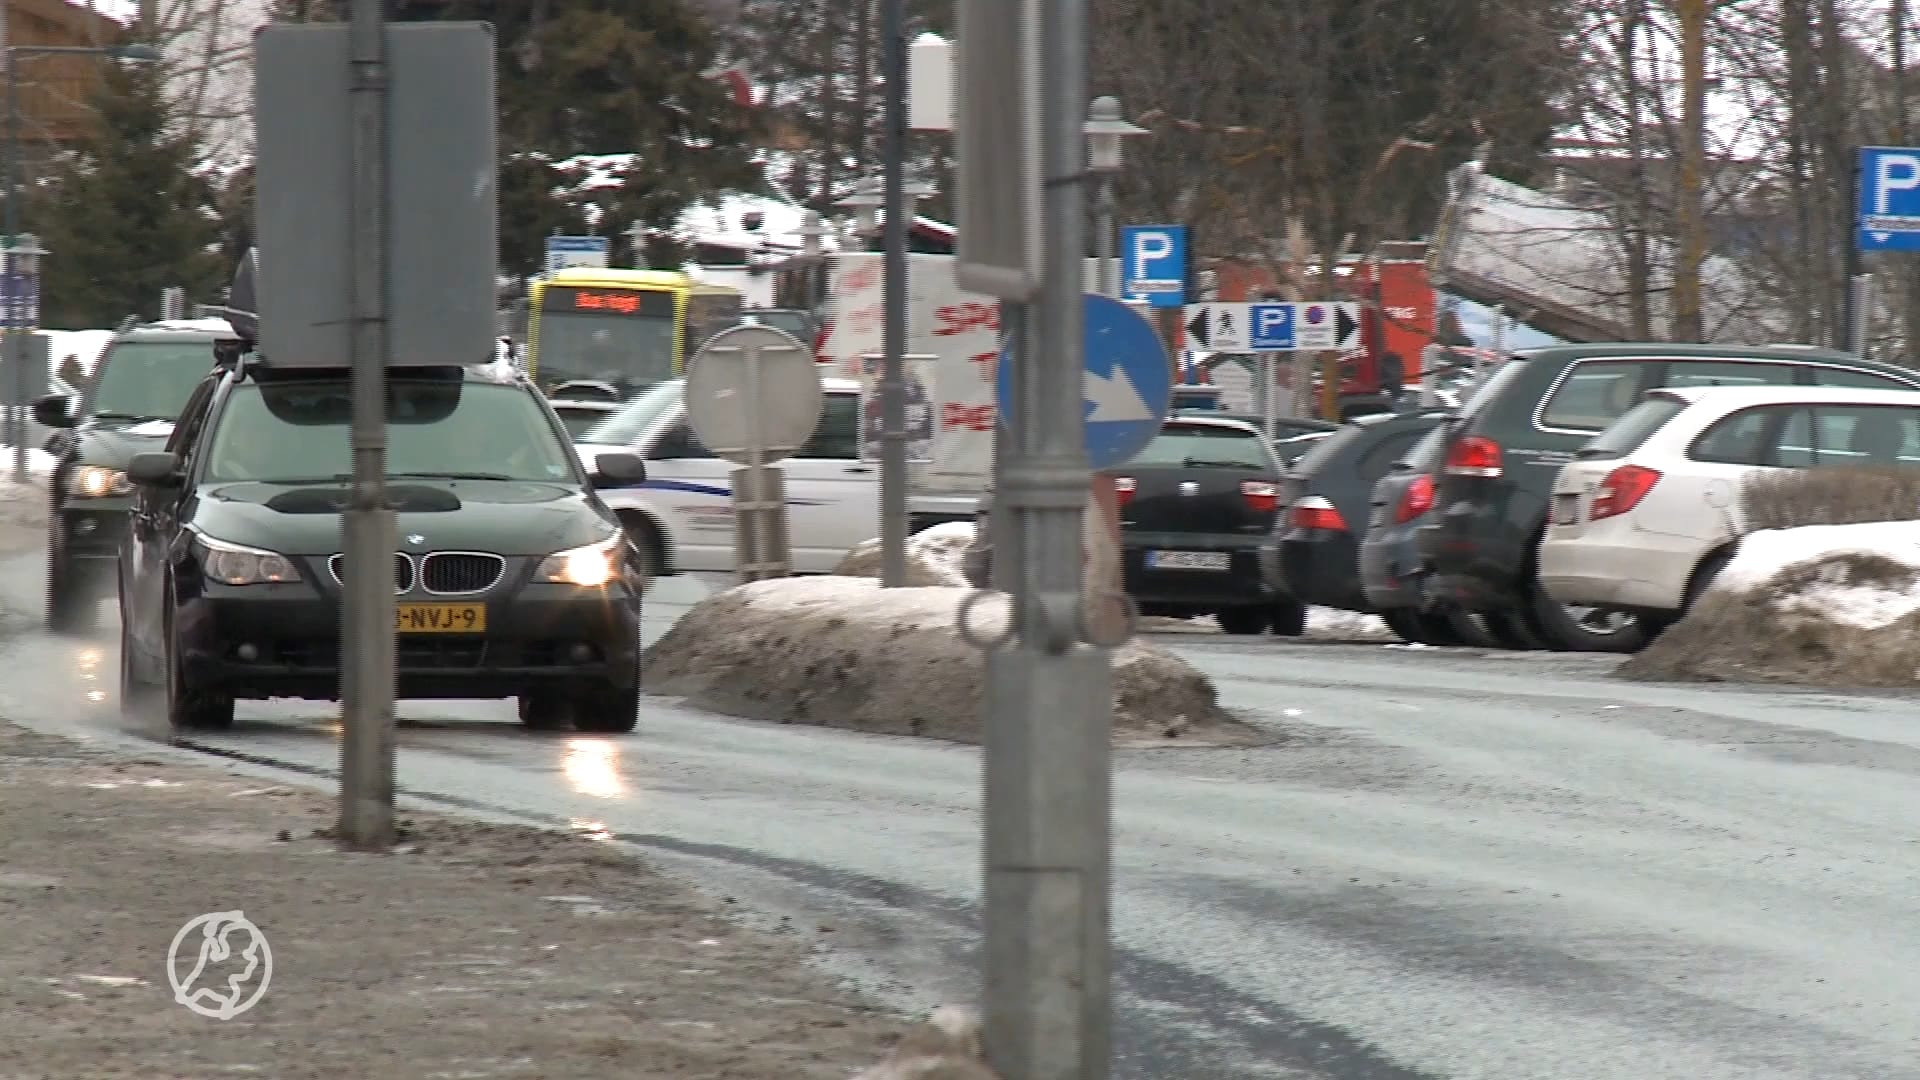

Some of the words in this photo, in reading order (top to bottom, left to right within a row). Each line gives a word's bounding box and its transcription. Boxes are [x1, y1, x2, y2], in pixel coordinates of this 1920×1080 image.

[1874, 154, 1920, 213] P
[1133, 231, 1174, 279] P
[1259, 309, 1287, 336] P
